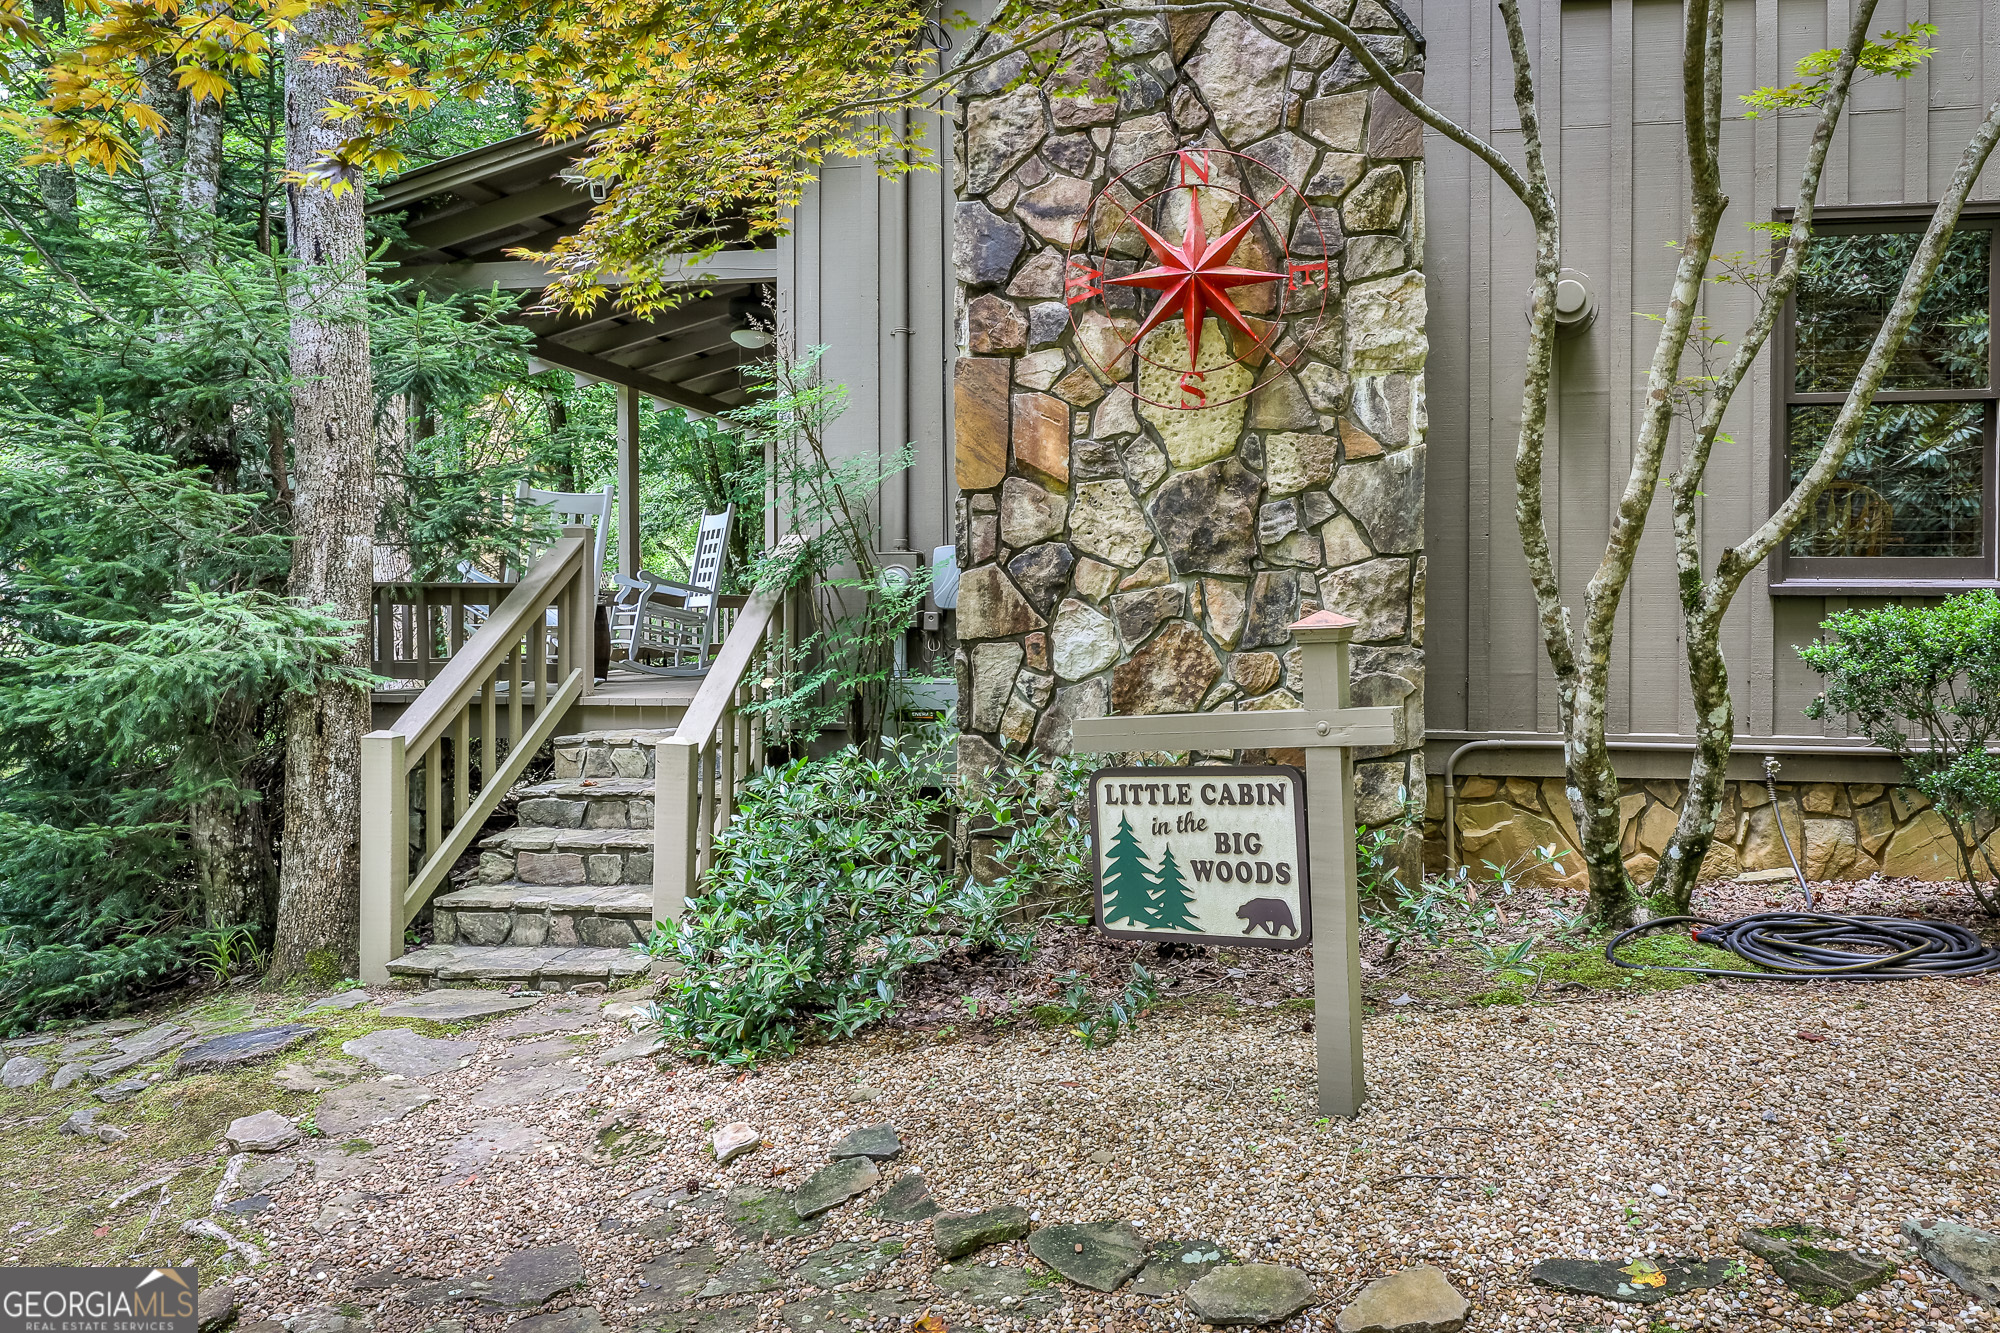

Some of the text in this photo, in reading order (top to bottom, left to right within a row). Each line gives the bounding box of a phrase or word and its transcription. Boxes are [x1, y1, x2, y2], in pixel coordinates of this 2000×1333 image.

[1178, 150, 1209, 186] N
[1288, 260, 1328, 291] E
[1179, 372, 1206, 409] S
[1104, 783, 1286, 806] LITTLE CABIN
[1151, 811, 1208, 835] in the
[1214, 832, 1263, 855] BIG
[1190, 860, 1291, 884] WOODS
